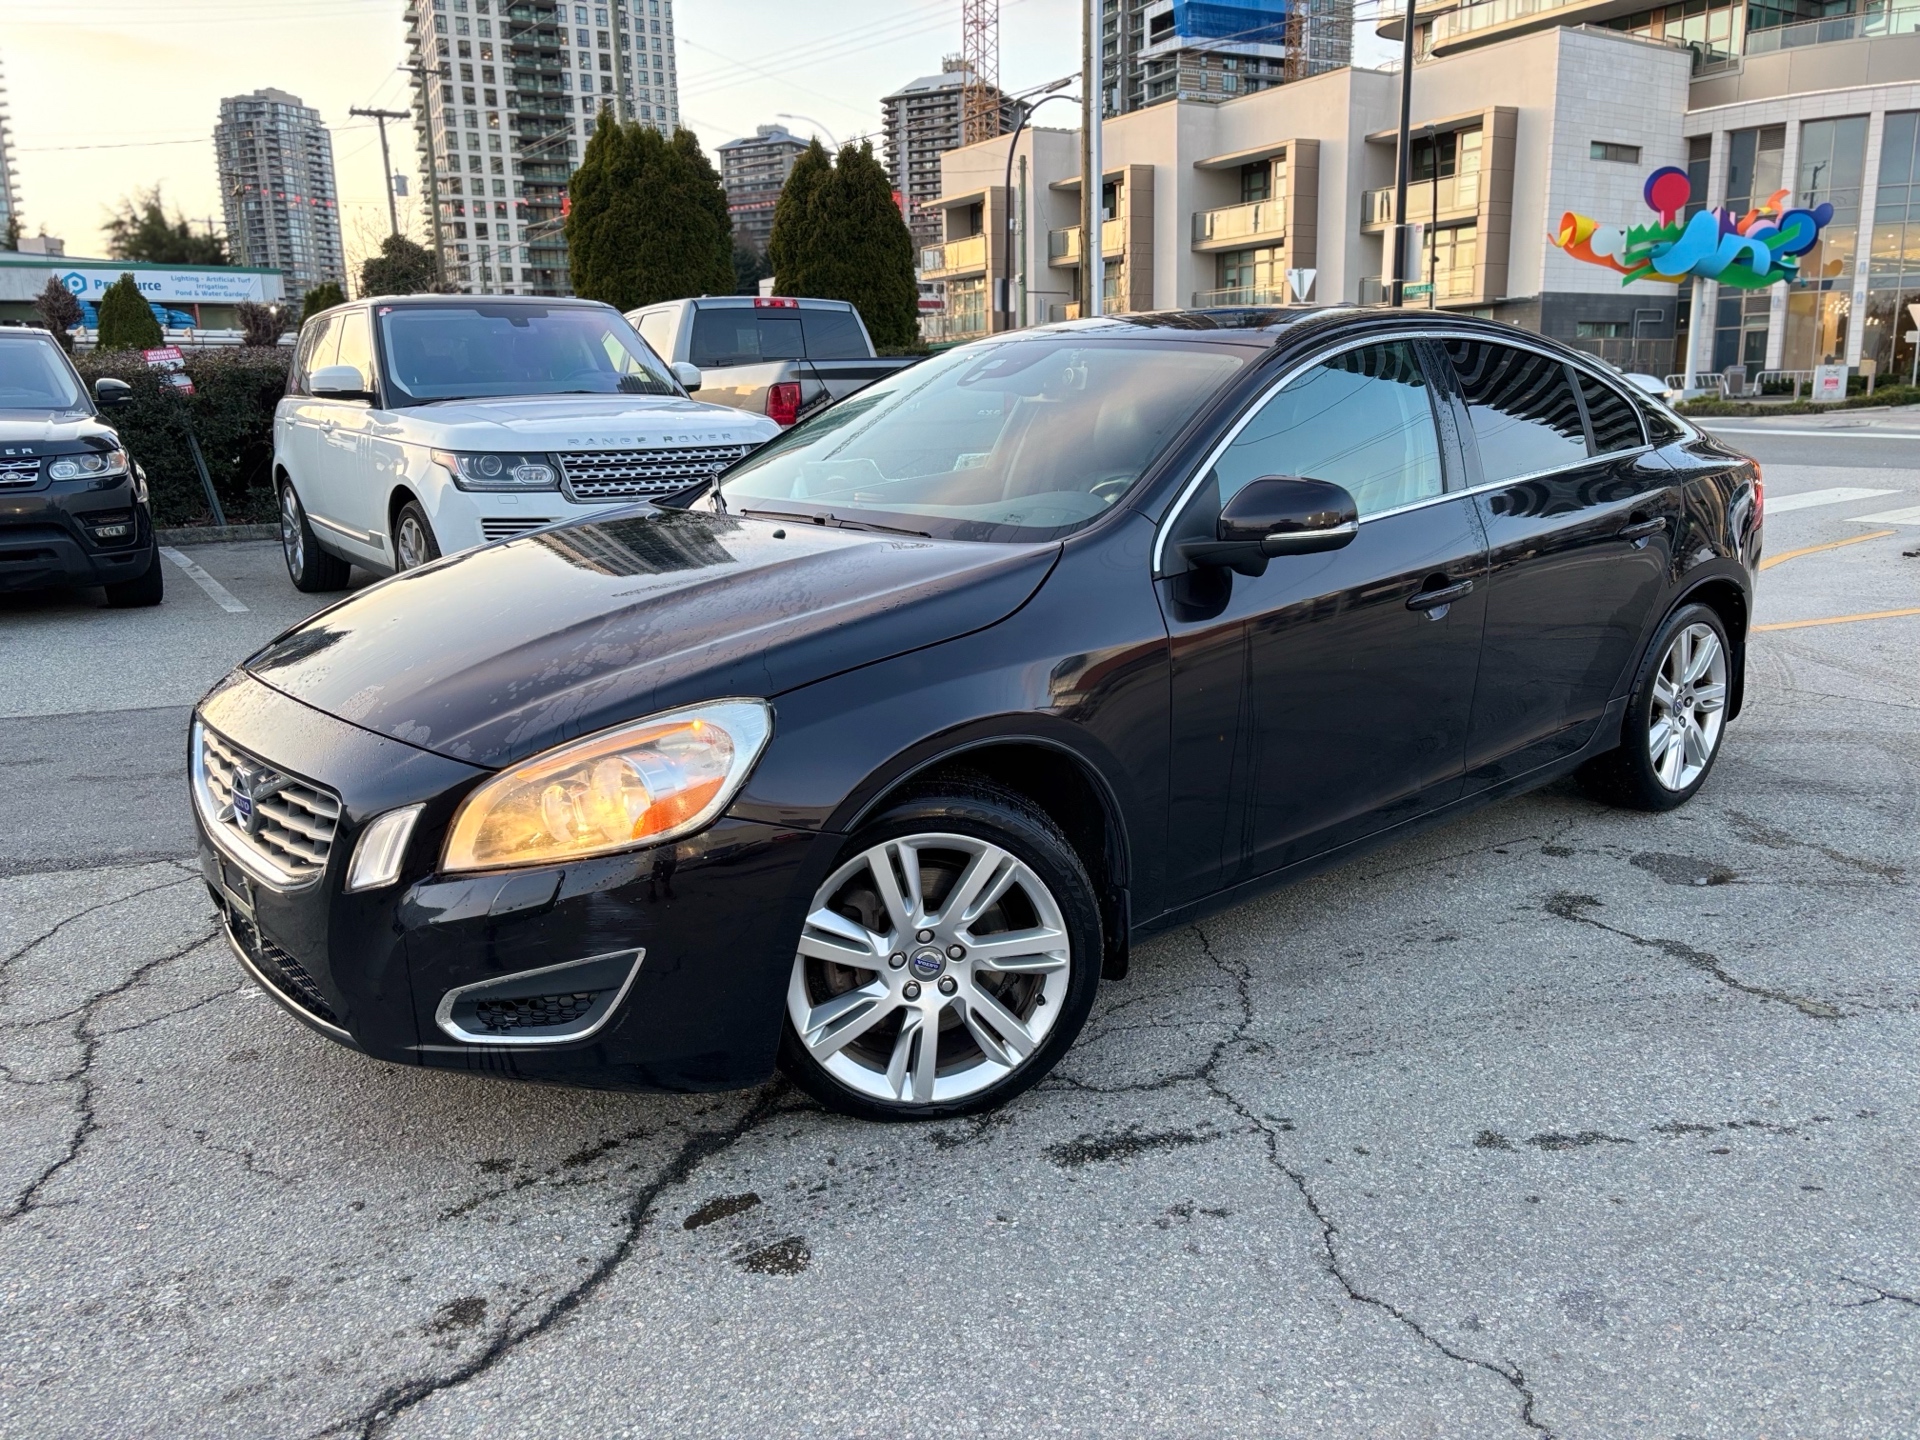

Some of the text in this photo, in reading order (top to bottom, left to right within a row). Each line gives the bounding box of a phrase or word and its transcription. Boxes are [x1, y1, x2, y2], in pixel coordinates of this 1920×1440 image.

[171, 275, 199, 283] Lighting
[94, 279, 162, 291] Prurce
[196, 283, 229, 291] Irrigation
[567, 433, 733, 446] RANGE ROVER
[916, 959, 939, 969] VOLVO
